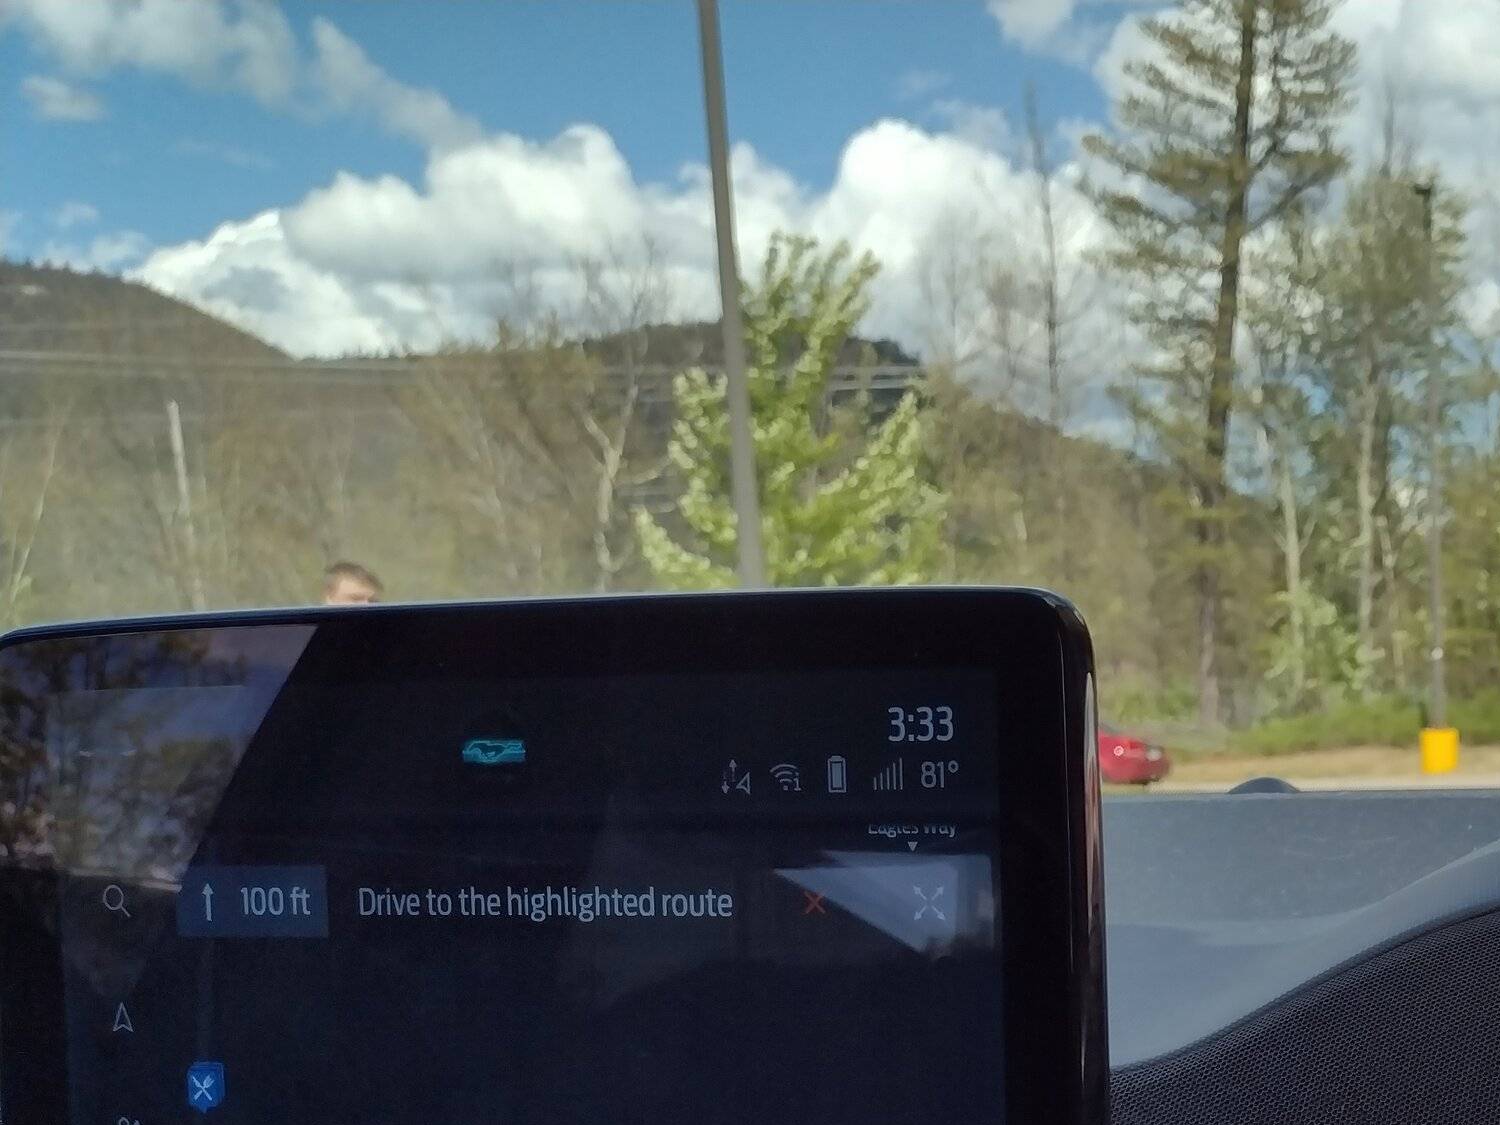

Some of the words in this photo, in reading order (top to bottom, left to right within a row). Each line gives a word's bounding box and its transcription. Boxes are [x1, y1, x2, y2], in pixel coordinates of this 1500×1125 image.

[887, 705, 954, 742] 3:33
[920, 759, 959, 789] 81°
[240, 886, 284, 917] 100
[289, 886, 311, 916] ft
[358, 887, 420, 917] Drive
[426, 889, 453, 917] to
[458, 887, 501, 917] the
[506, 887, 656, 923] highlighted
[661, 889, 733, 918] route
